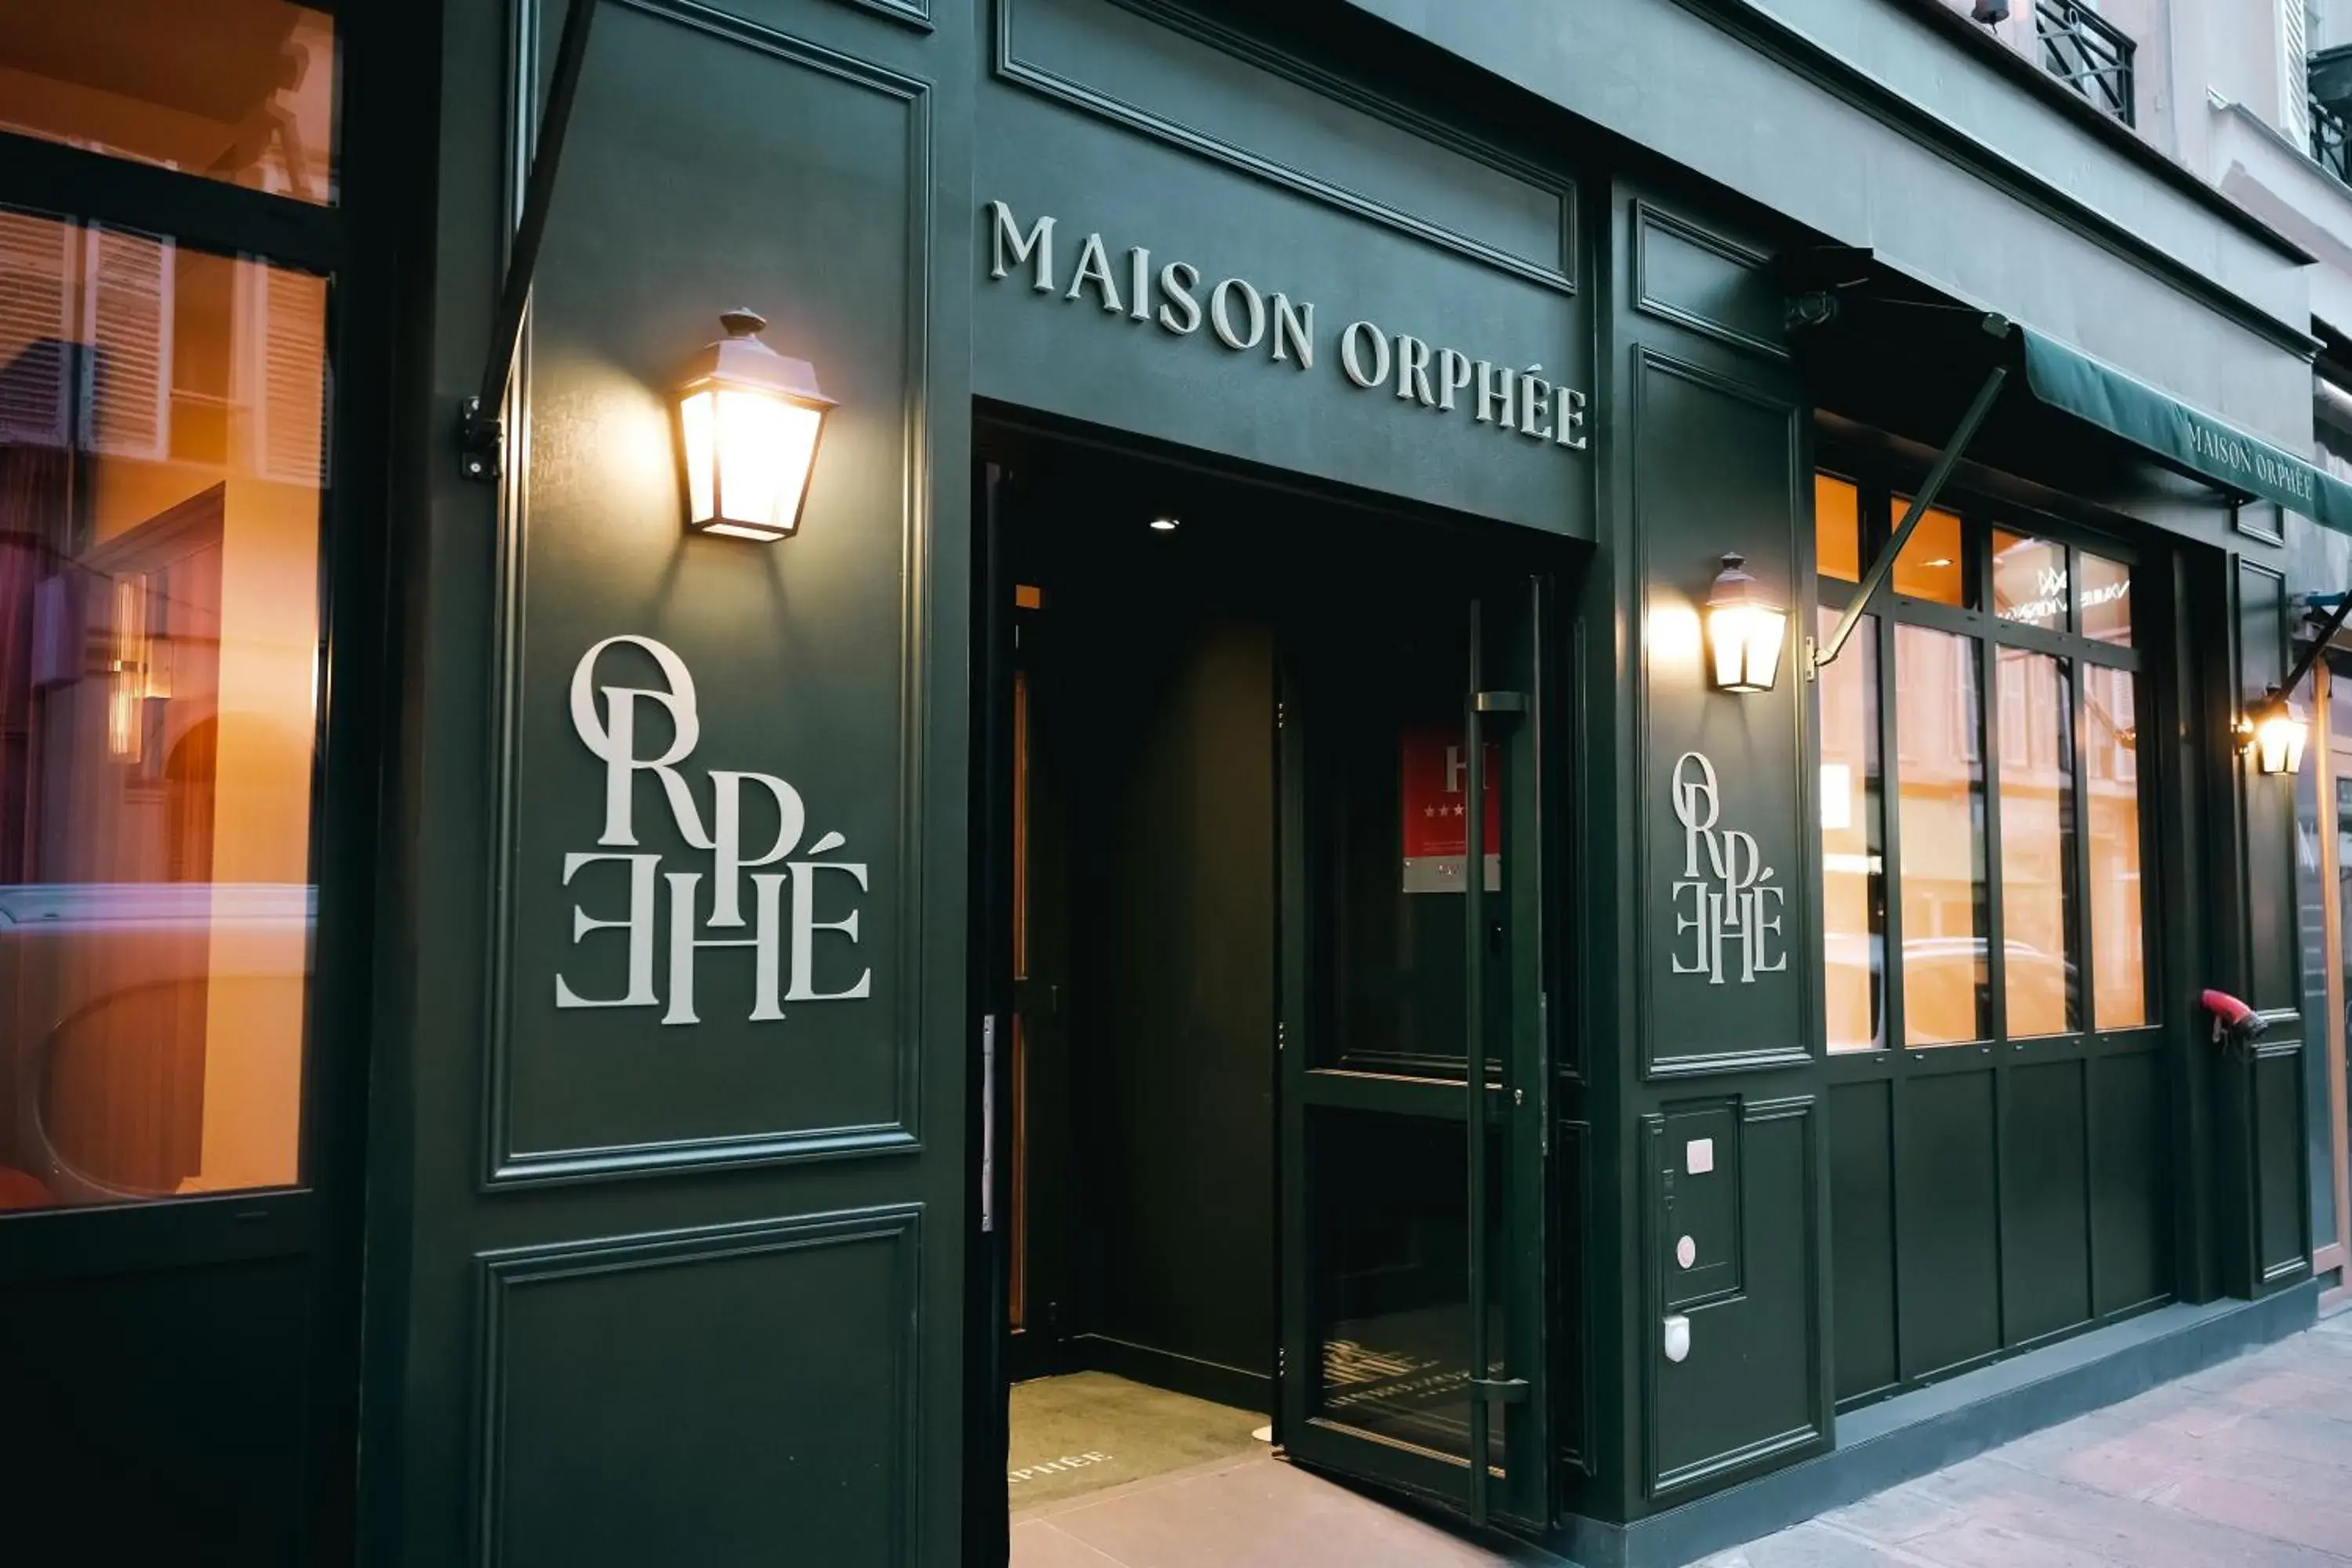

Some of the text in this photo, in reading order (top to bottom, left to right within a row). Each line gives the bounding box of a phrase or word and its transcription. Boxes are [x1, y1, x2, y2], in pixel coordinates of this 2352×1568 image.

[990, 200, 1588, 450] MAISON ORPHÉE
[2188, 422, 2312, 501] MAISON ORPHÉE
[1008, 1450, 1113, 1483] PHÉE
